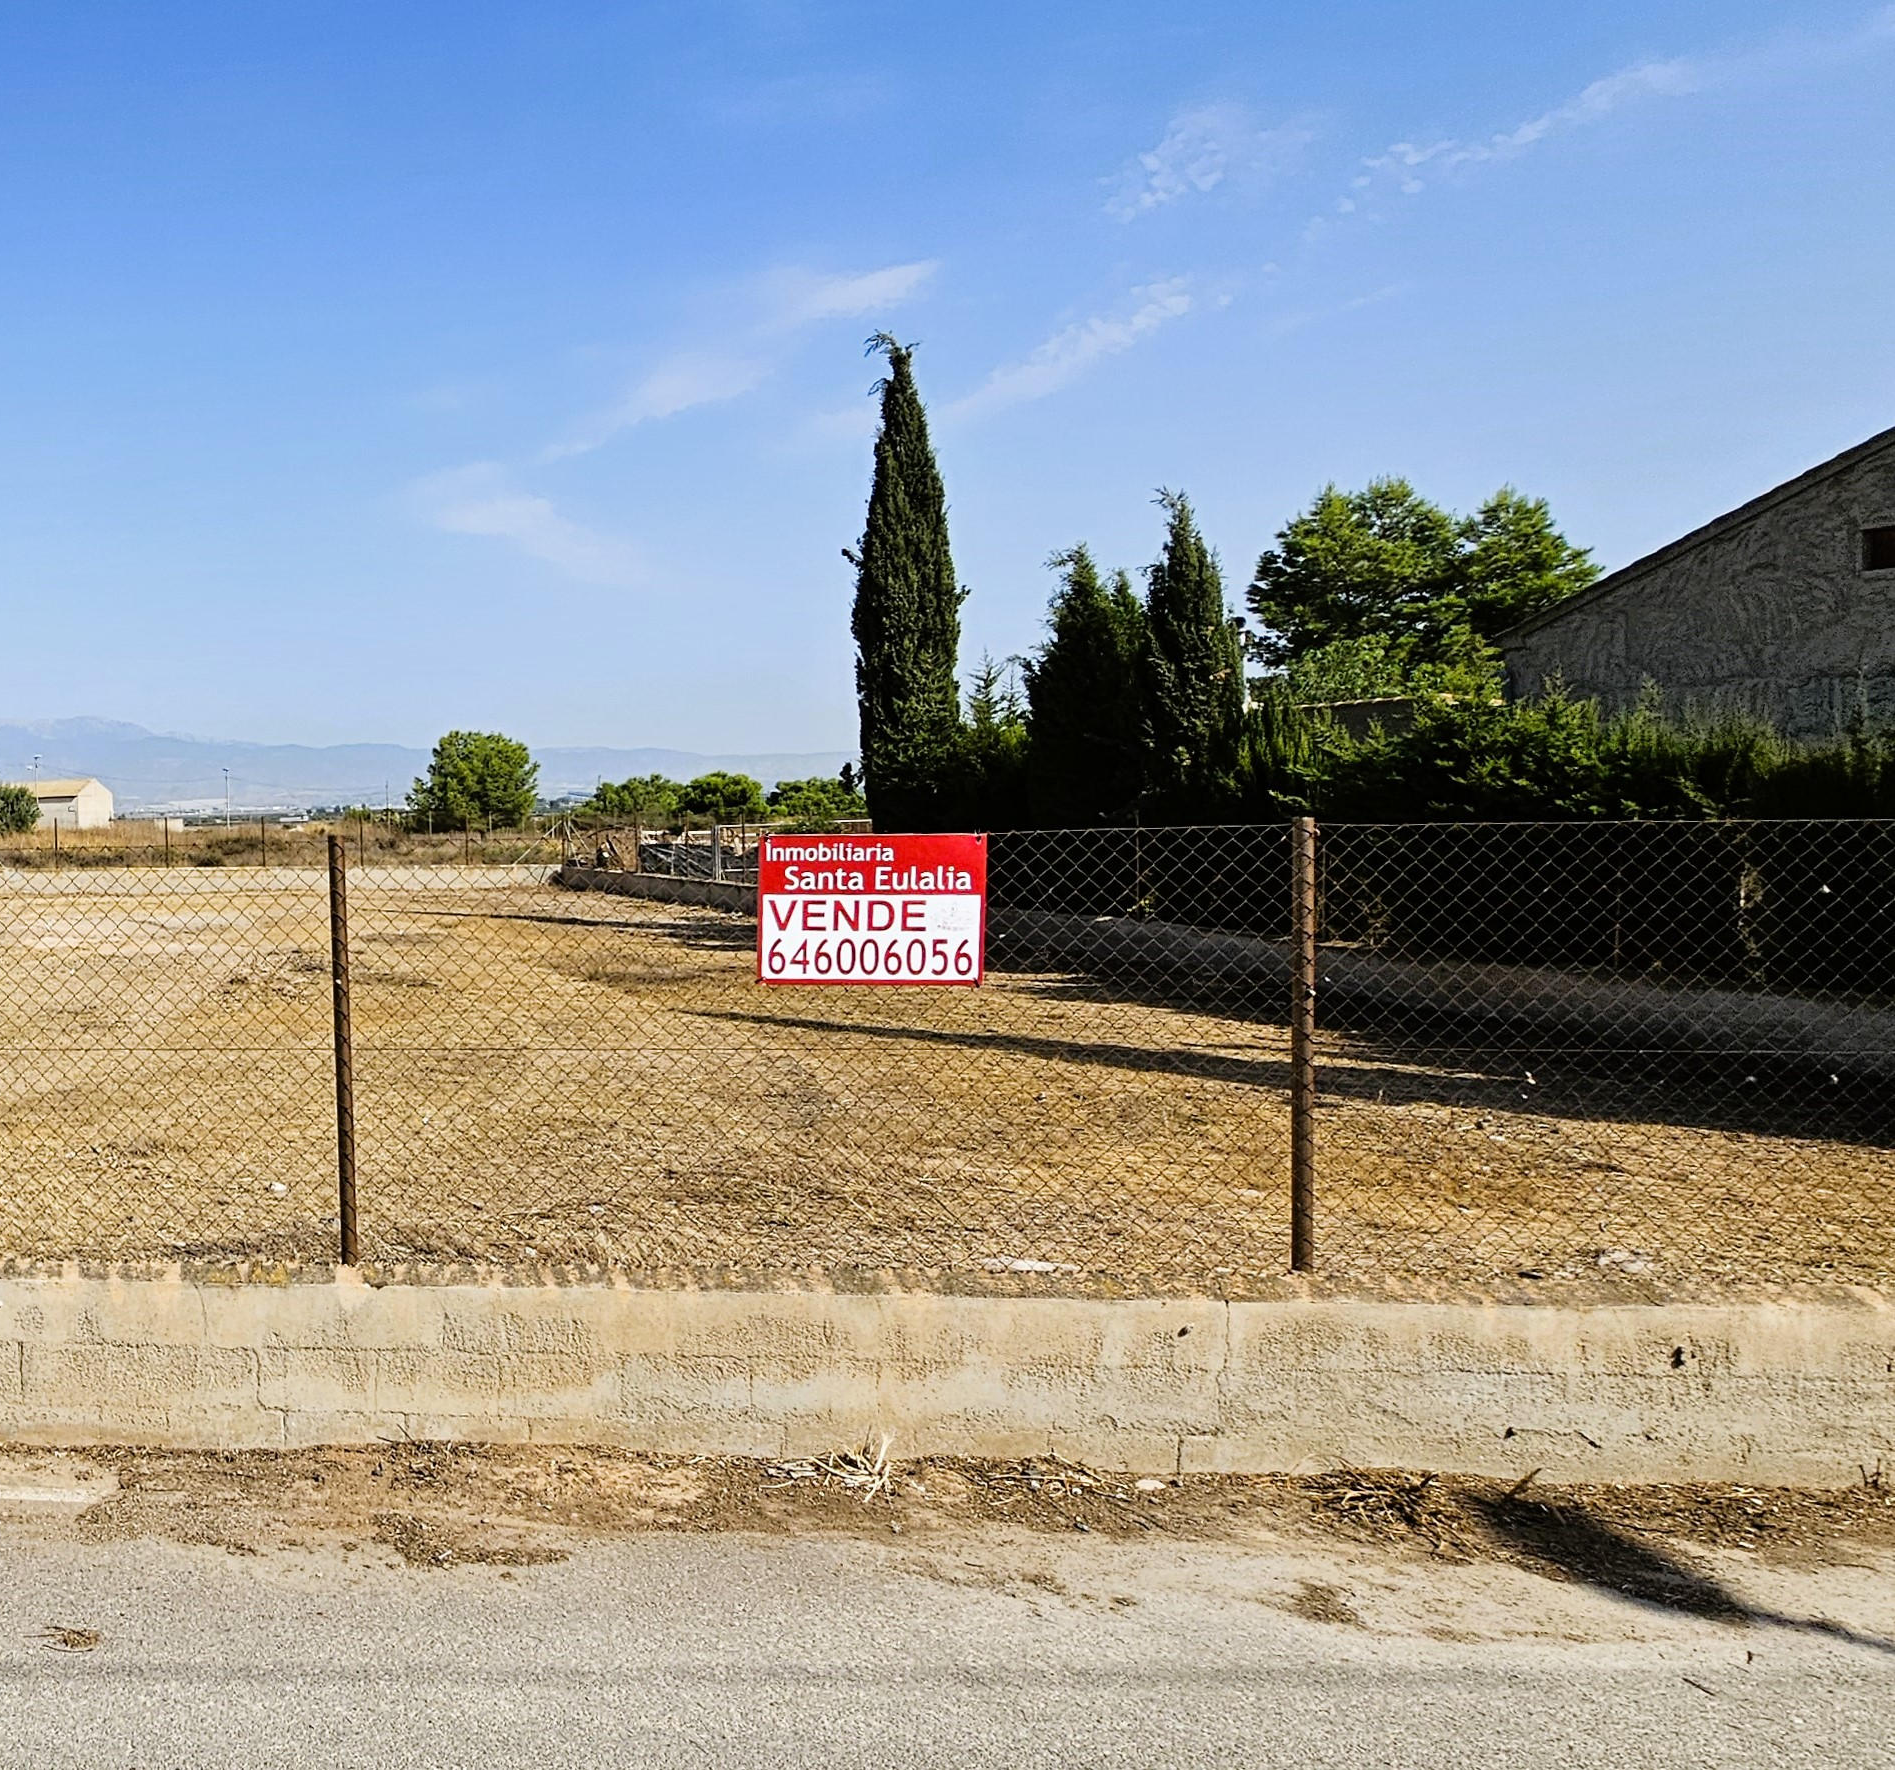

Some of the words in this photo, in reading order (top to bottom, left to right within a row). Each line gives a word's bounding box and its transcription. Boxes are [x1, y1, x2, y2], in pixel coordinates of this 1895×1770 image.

[765, 840, 894, 862] Inmobiliaria
[784, 866, 864, 891] Santa
[874, 866, 972, 890] Eulalia
[768, 899, 927, 932] VENDE
[768, 938, 973, 976] 646006056
